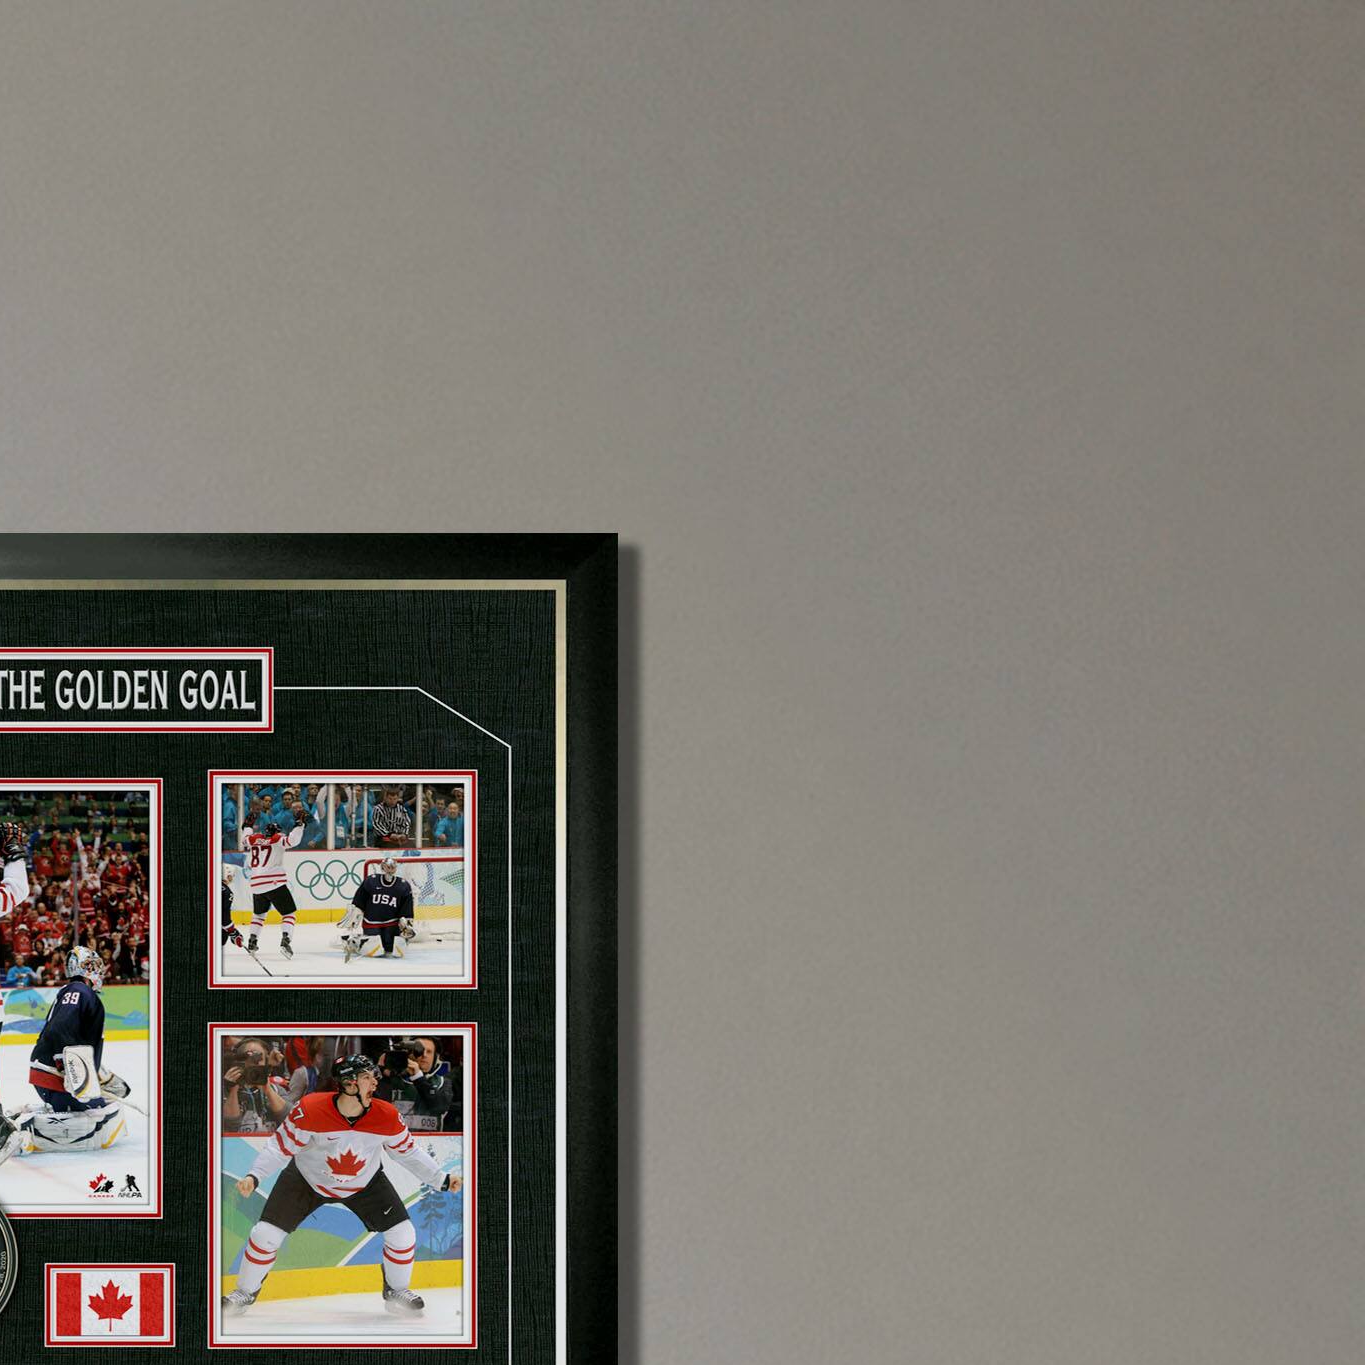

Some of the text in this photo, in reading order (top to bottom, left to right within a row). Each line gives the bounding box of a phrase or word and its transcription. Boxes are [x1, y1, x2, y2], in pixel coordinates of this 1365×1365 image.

[55, 669, 169, 710] GOLDEN
[179, 669, 256, 710] GOAL
[251, 845, 272, 868] 87
[372, 894, 397, 907] USA
[61, 992, 80, 1005] 39
[0, 1250, 7, 1270] 2020
